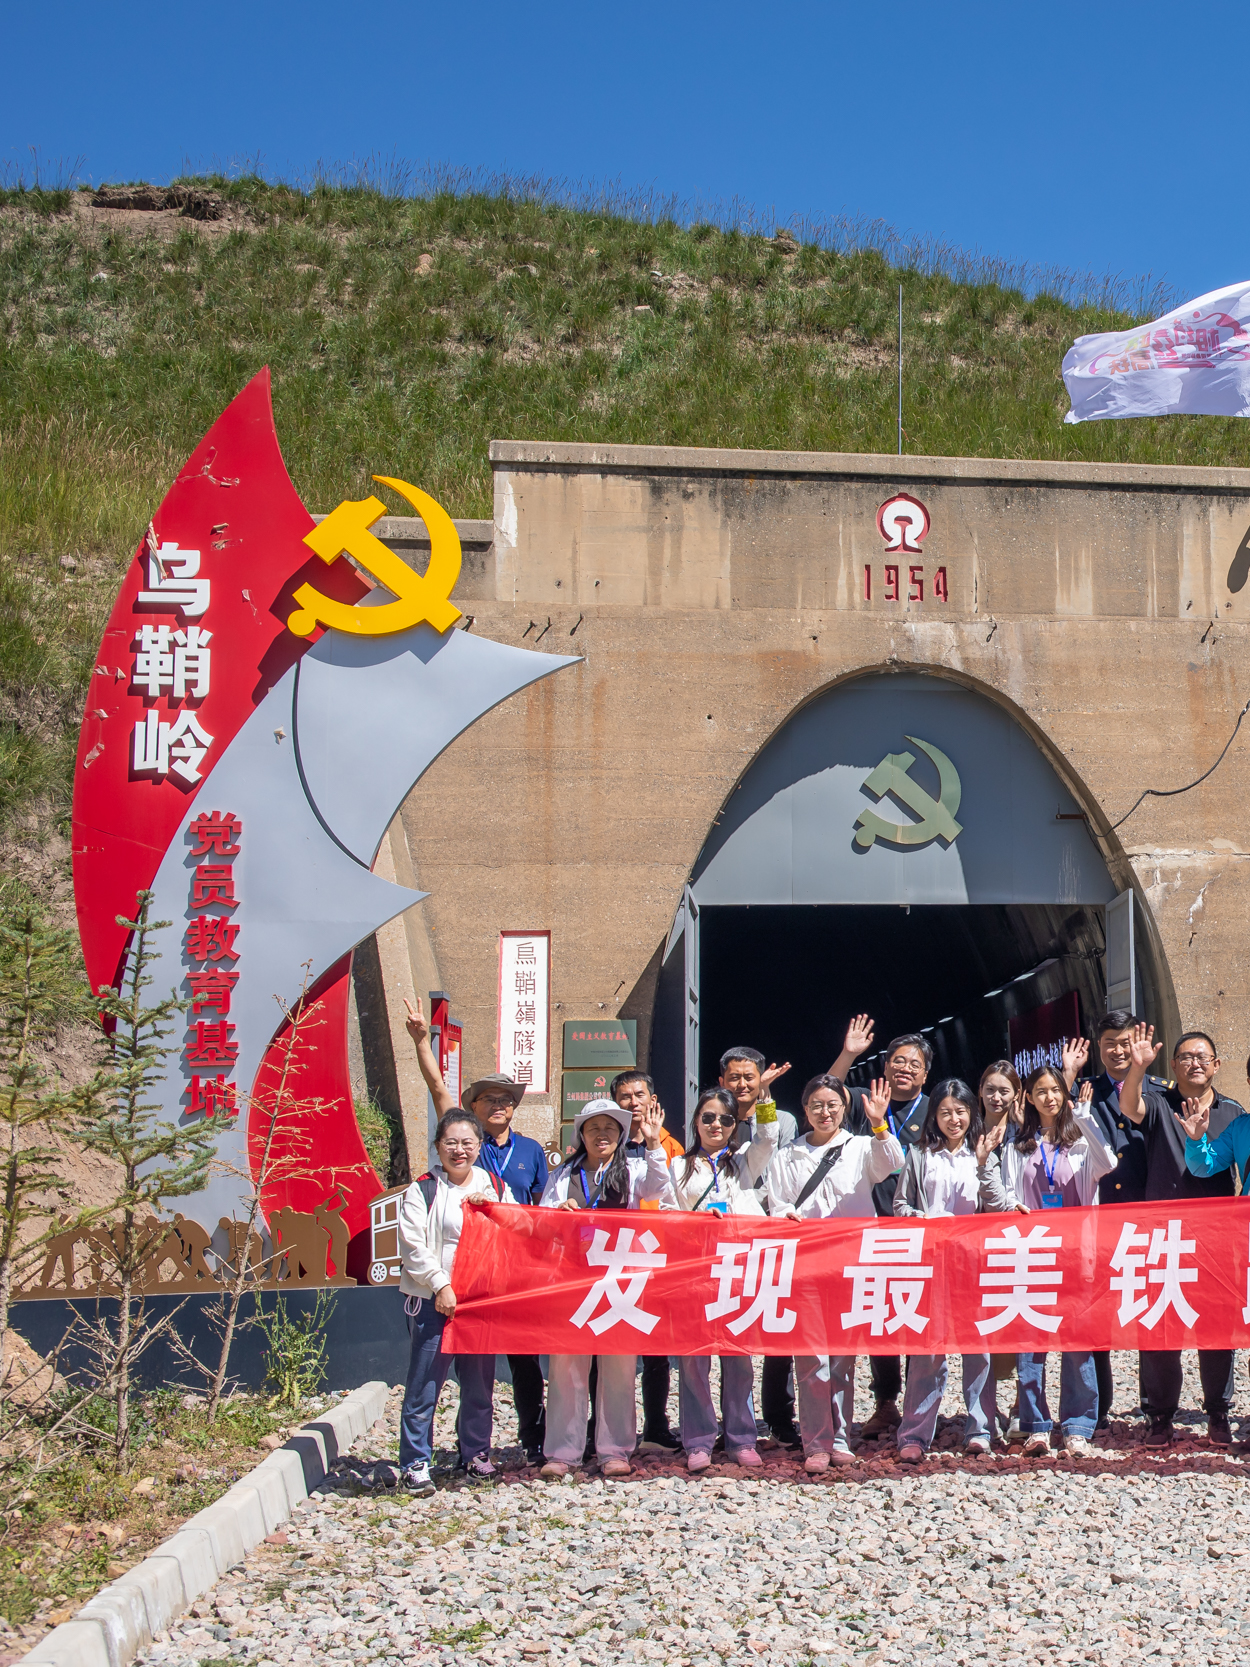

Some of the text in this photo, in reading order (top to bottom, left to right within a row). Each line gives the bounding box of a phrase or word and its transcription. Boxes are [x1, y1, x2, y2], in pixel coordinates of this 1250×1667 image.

[133, 542, 213, 783] 乌鞘岭
[864, 565, 948, 602] 1954
[185, 810, 242, 1119] 党员教育基地
[512, 942, 537, 1086] 烏鞘嶺隧道
